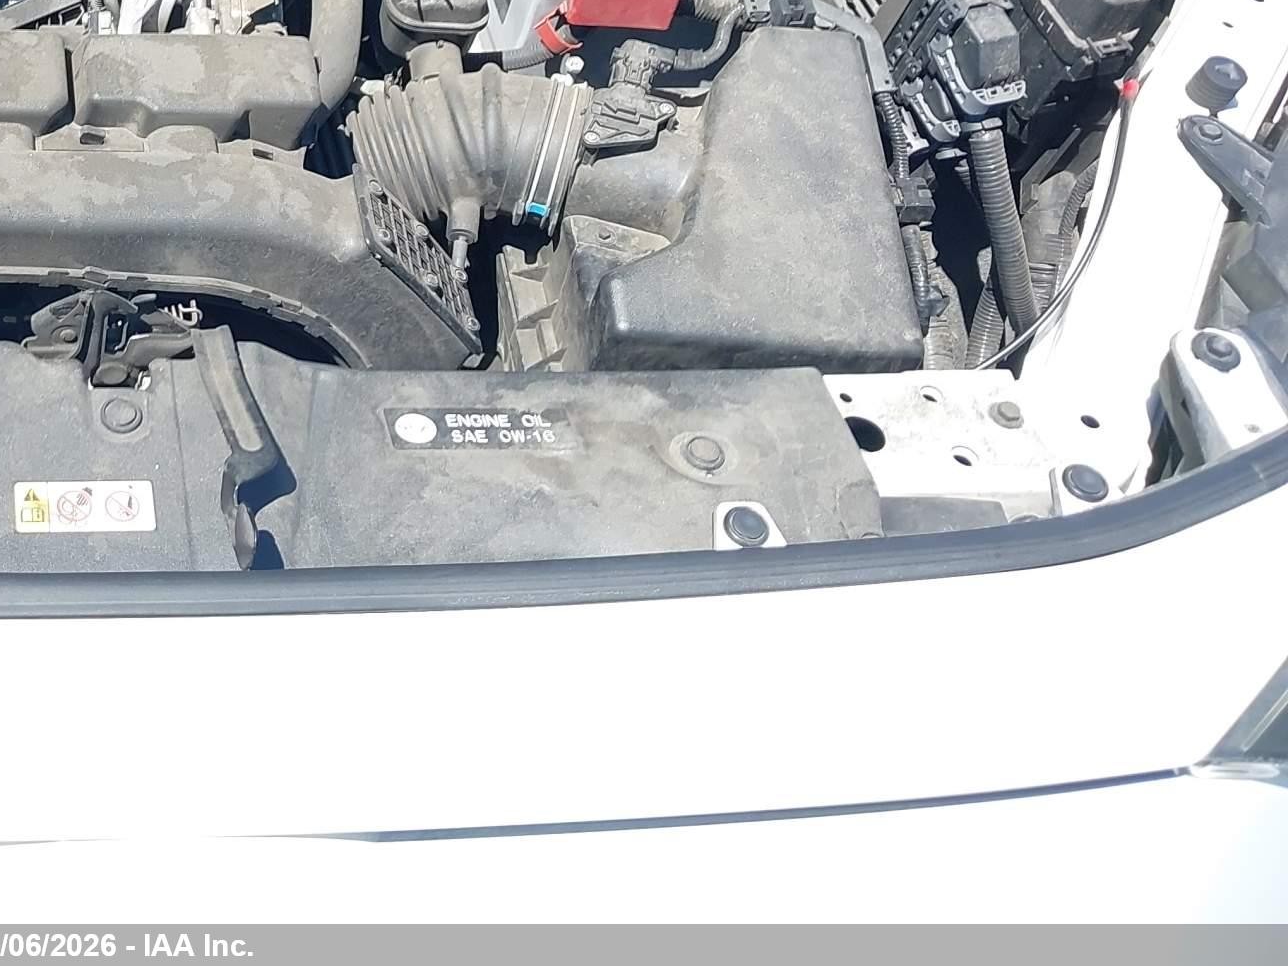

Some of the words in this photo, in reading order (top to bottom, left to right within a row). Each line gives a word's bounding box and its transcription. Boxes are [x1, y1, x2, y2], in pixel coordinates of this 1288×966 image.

[444, 413, 512, 428] ENGINE
[521, 413, 552, 428] OIL
[451, 429, 489, 443] SAE
[499, 429, 556, 443] 0W-16
